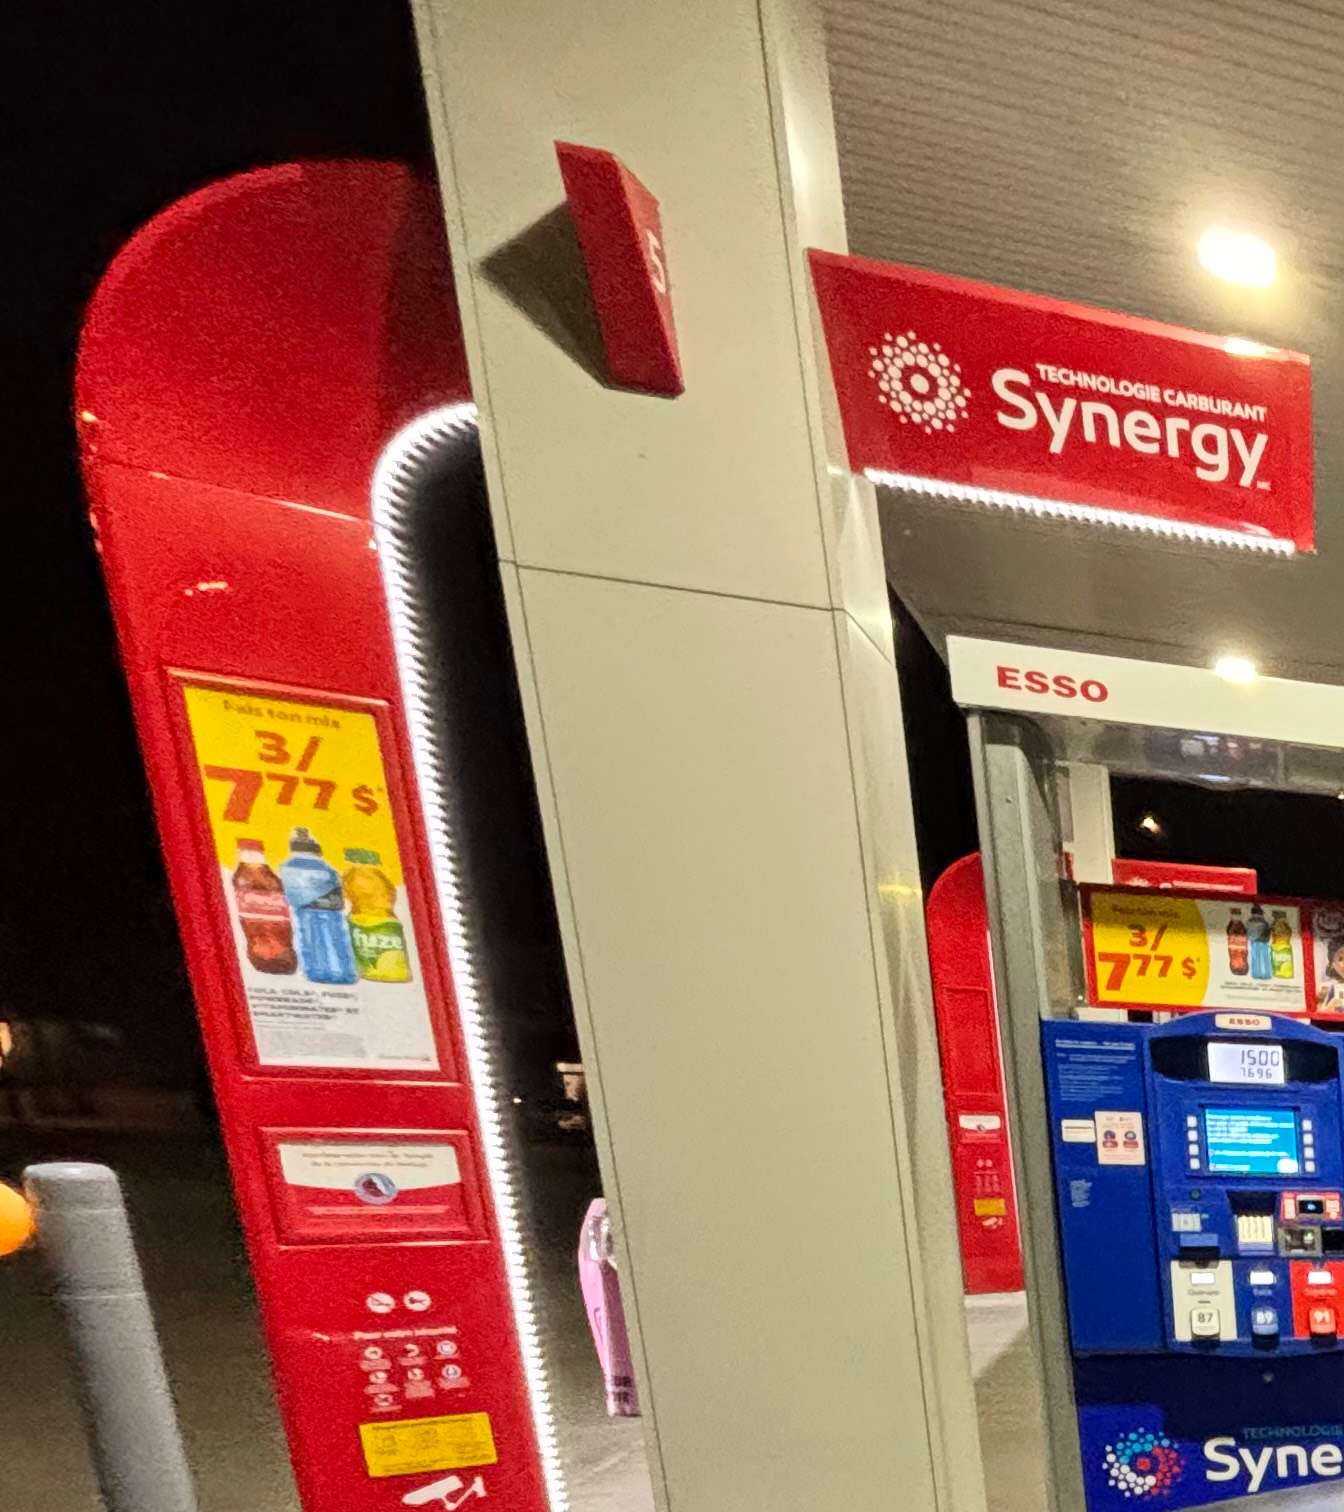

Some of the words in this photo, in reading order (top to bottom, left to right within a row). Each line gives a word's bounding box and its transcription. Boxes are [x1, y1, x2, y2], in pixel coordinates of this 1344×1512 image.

[1035, 363, 1161, 402] TECHNOLOGIE
[1163, 389, 1268, 422] CARBURANT
[991, 368, 1269, 490] Synergy
[996, 665, 1109, 703] ESSO
[255, 730, 323, 773] 3/
[1128, 924, 1168, 951] 3/
[1197, 1312, 1213, 1323] 87
[1243, 1424, 1343, 1440] TECHNOLOGIE
